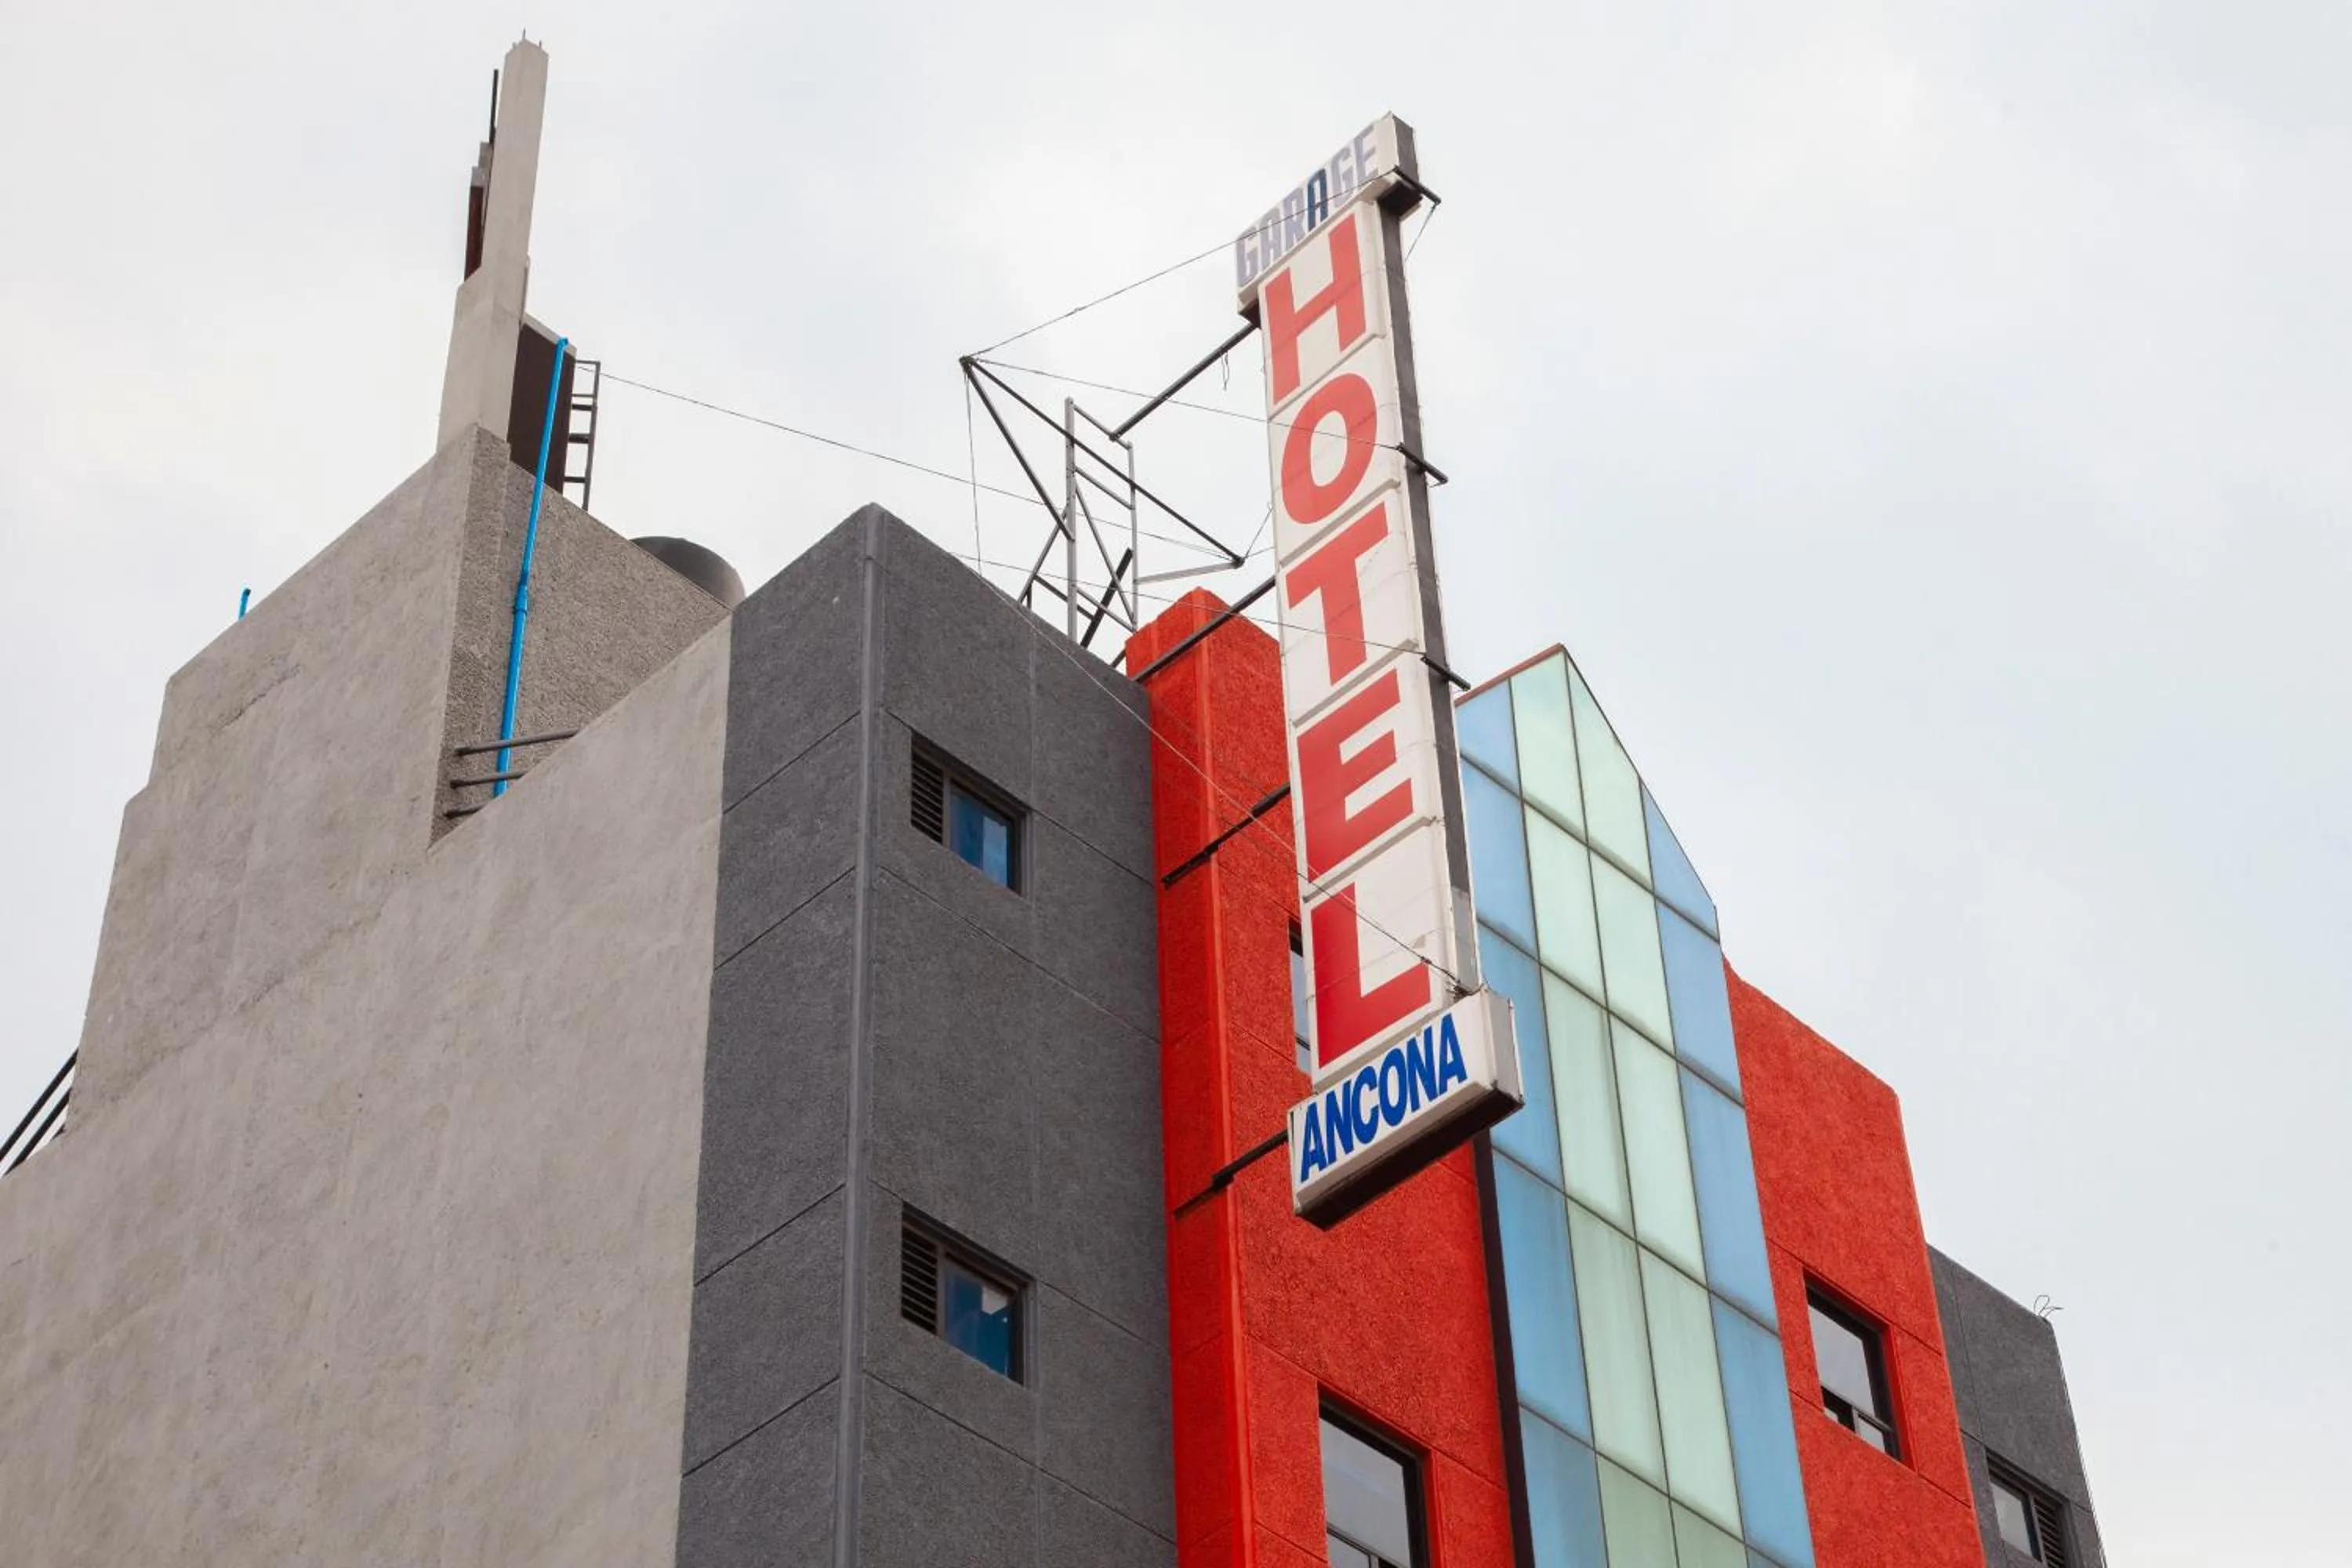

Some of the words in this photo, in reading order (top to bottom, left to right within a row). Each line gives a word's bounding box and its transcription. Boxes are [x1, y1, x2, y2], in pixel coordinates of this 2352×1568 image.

[1236, 123, 1379, 287] GARAGE
[1265, 212, 1431, 1069] HOTEL
[1301, 1013, 1467, 1182] ANCONA
